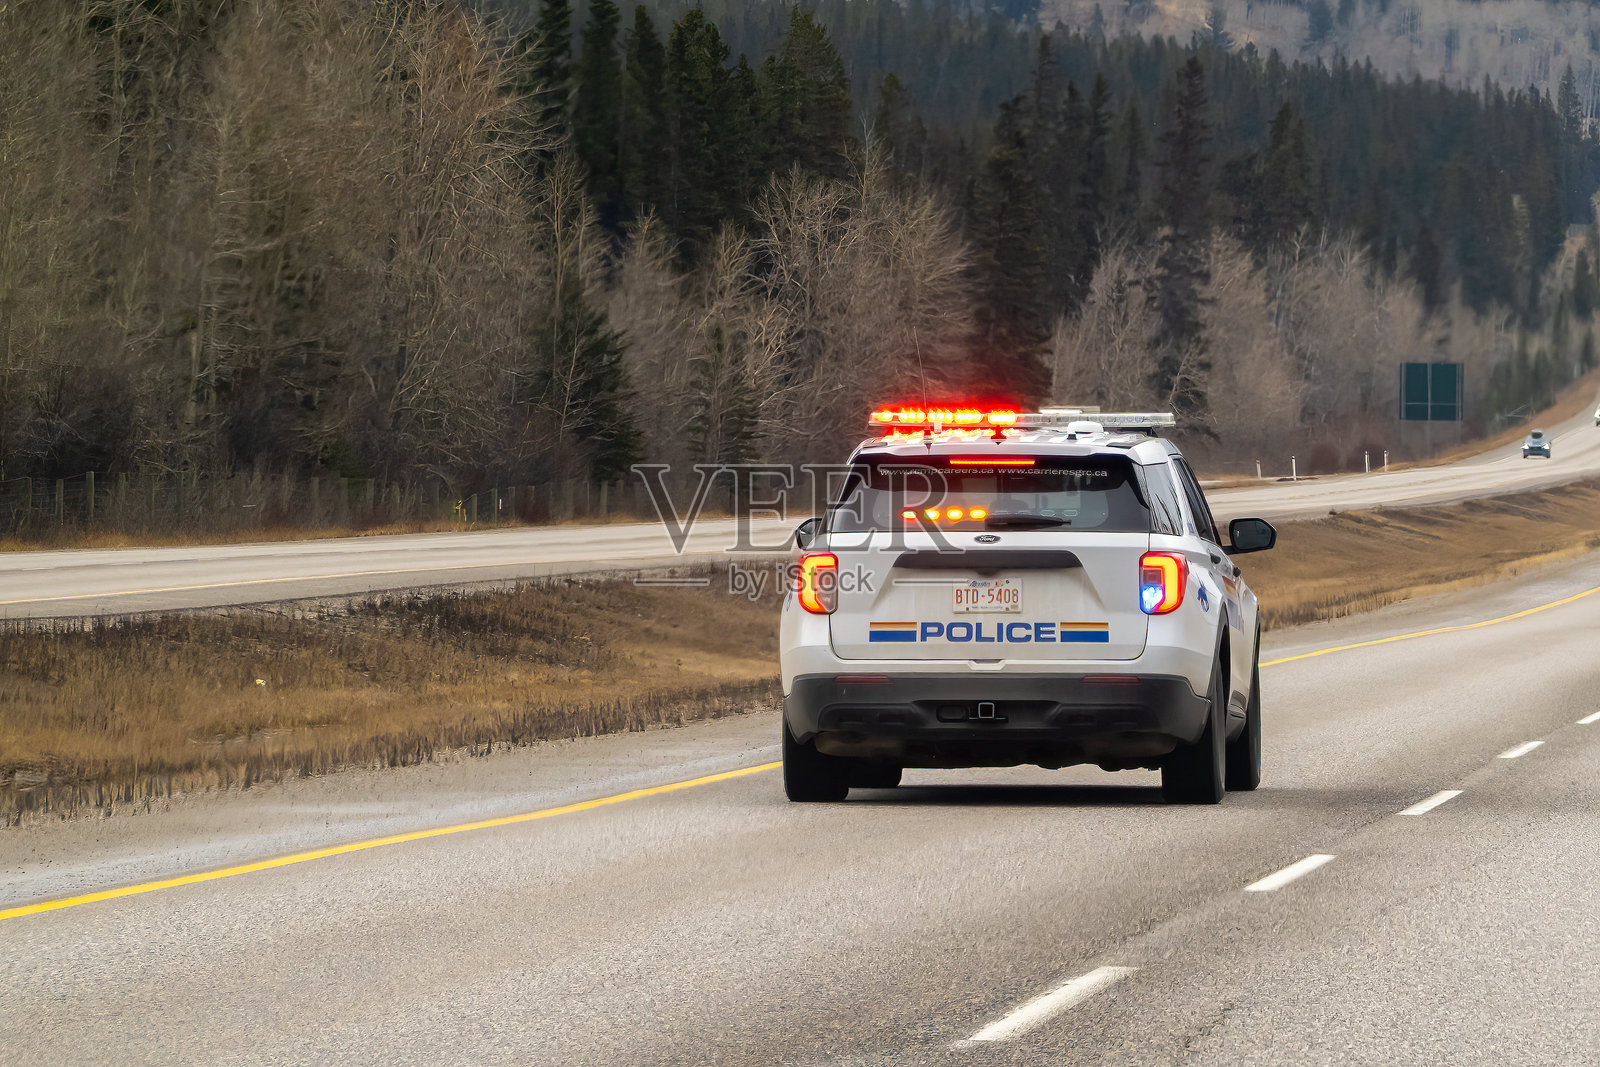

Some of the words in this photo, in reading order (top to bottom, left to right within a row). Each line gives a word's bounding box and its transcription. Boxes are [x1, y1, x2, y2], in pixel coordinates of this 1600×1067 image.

[997, 467, 1108, 477] www.carrieresgrc.ca
[955, 588, 1019, 604] BTD-5408
[920, 622, 1057, 643] POLICE
